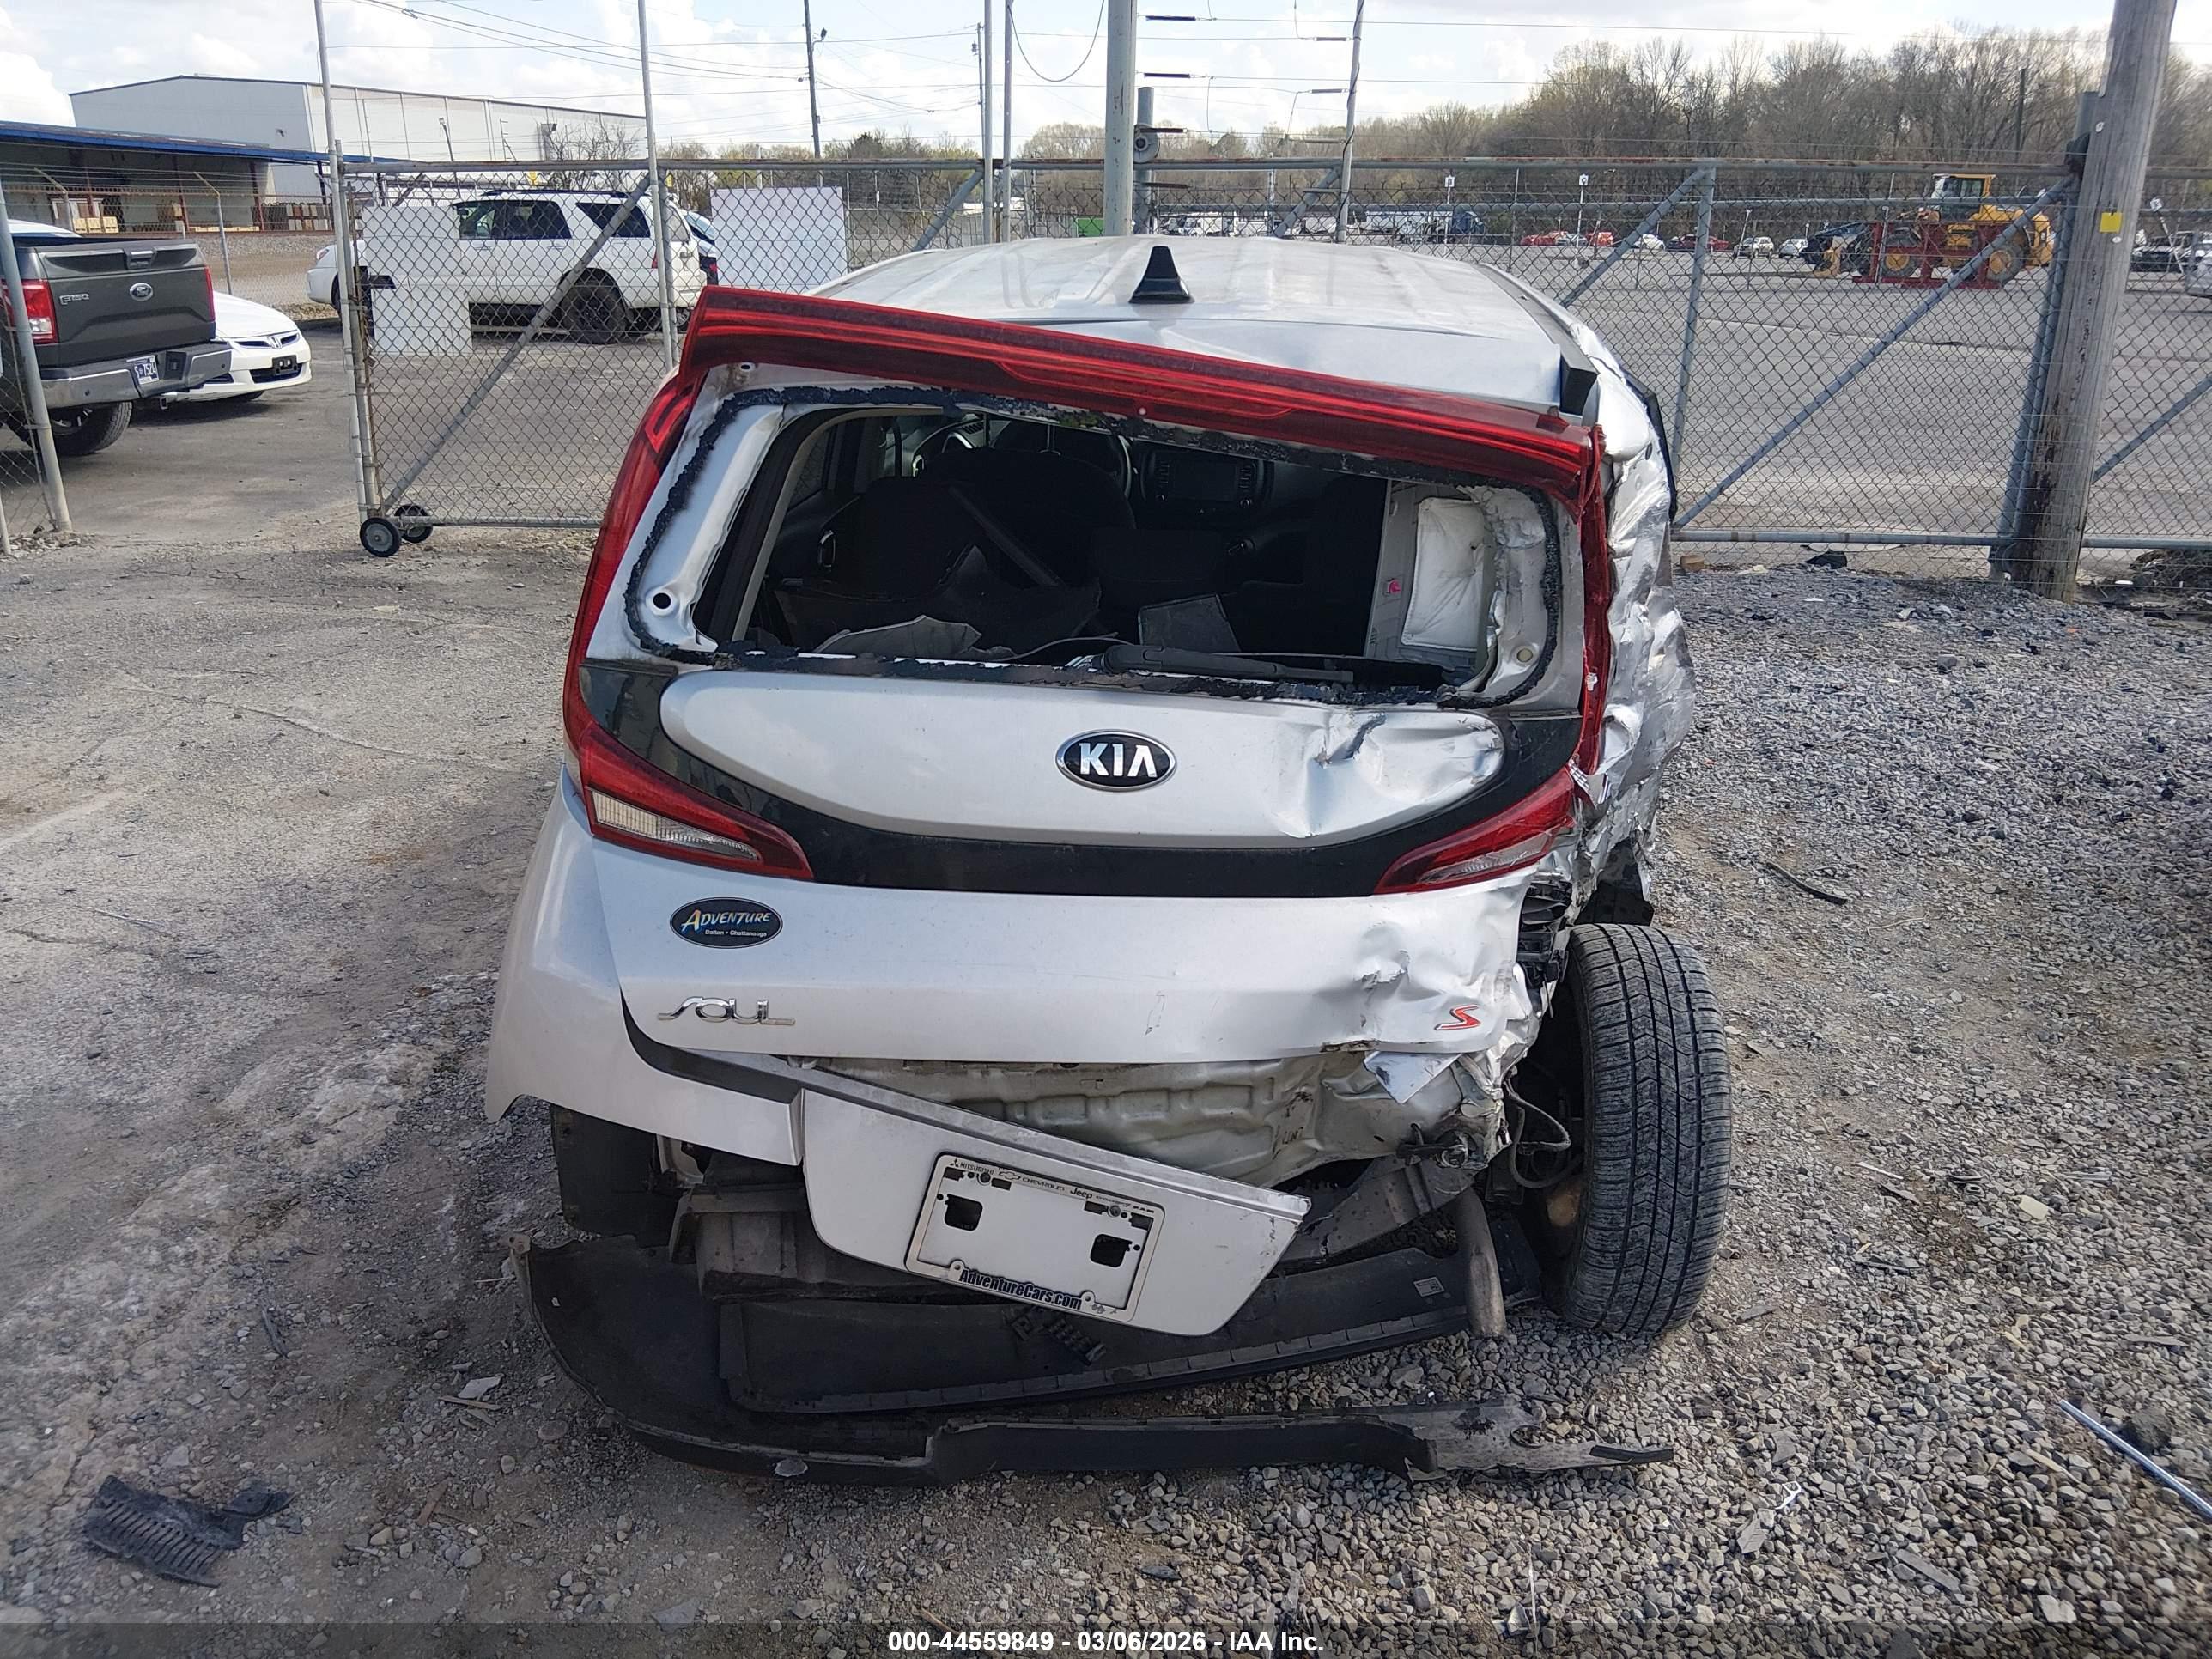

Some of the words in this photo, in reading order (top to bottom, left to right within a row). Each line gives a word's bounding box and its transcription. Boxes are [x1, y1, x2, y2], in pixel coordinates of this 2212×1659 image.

[1079, 742, 1158, 778] KIA
[729, 929, 768, 938] Chattanooga
[1434, 1004, 1481, 1030] S
[959, 1162, 995, 1176] MITSUBISHI
[1022, 1177, 1066, 1192] CHEVROLET
[1069, 1188, 1093, 1200] Jeep
[958, 1268, 1083, 1311] AdventureCars.com
